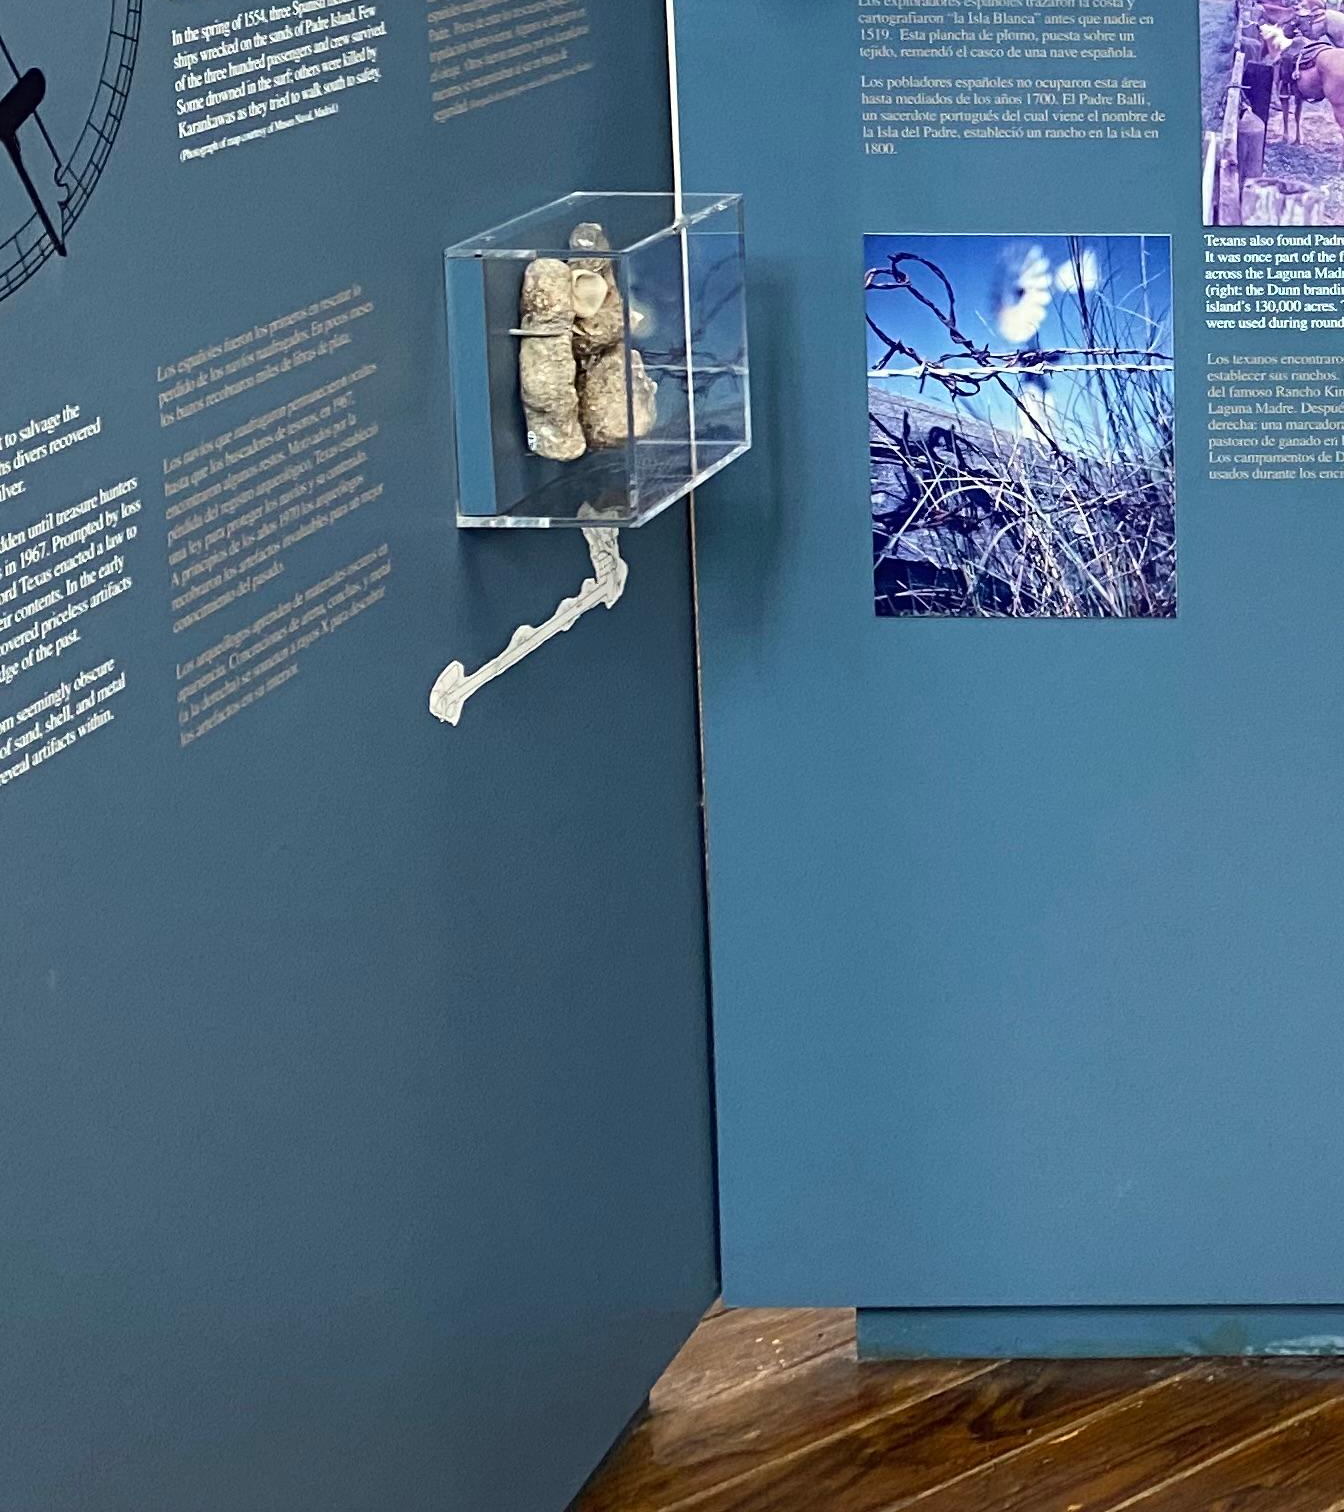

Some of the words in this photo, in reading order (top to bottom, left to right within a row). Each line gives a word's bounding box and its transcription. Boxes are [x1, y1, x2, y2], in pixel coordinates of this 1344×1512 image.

[1204, 235, 1246, 246] Texans
[1250, 235, 1274, 246] also
[1277, 235, 1311, 246] found
[1208, 353, 1229, 364] Los
[1233, 355, 1277, 364] texanos
[5, 433, 17, 448] to
[19, 419, 61, 441] salvage
[62, 403, 80, 423] the
[13, 445, 48, 470] divers
[49, 416, 101, 455] recovered
[27, 513, 54, 539] until
[55, 494, 99, 526] treasure
[99, 476, 139, 504] hunters
[5, 560, 17, 577] in
[20, 541, 50, 570] 1967.
[51, 517, 104, 553] Prompted
[105, 509, 119, 527] by
[121, 499, 142, 518] loss
